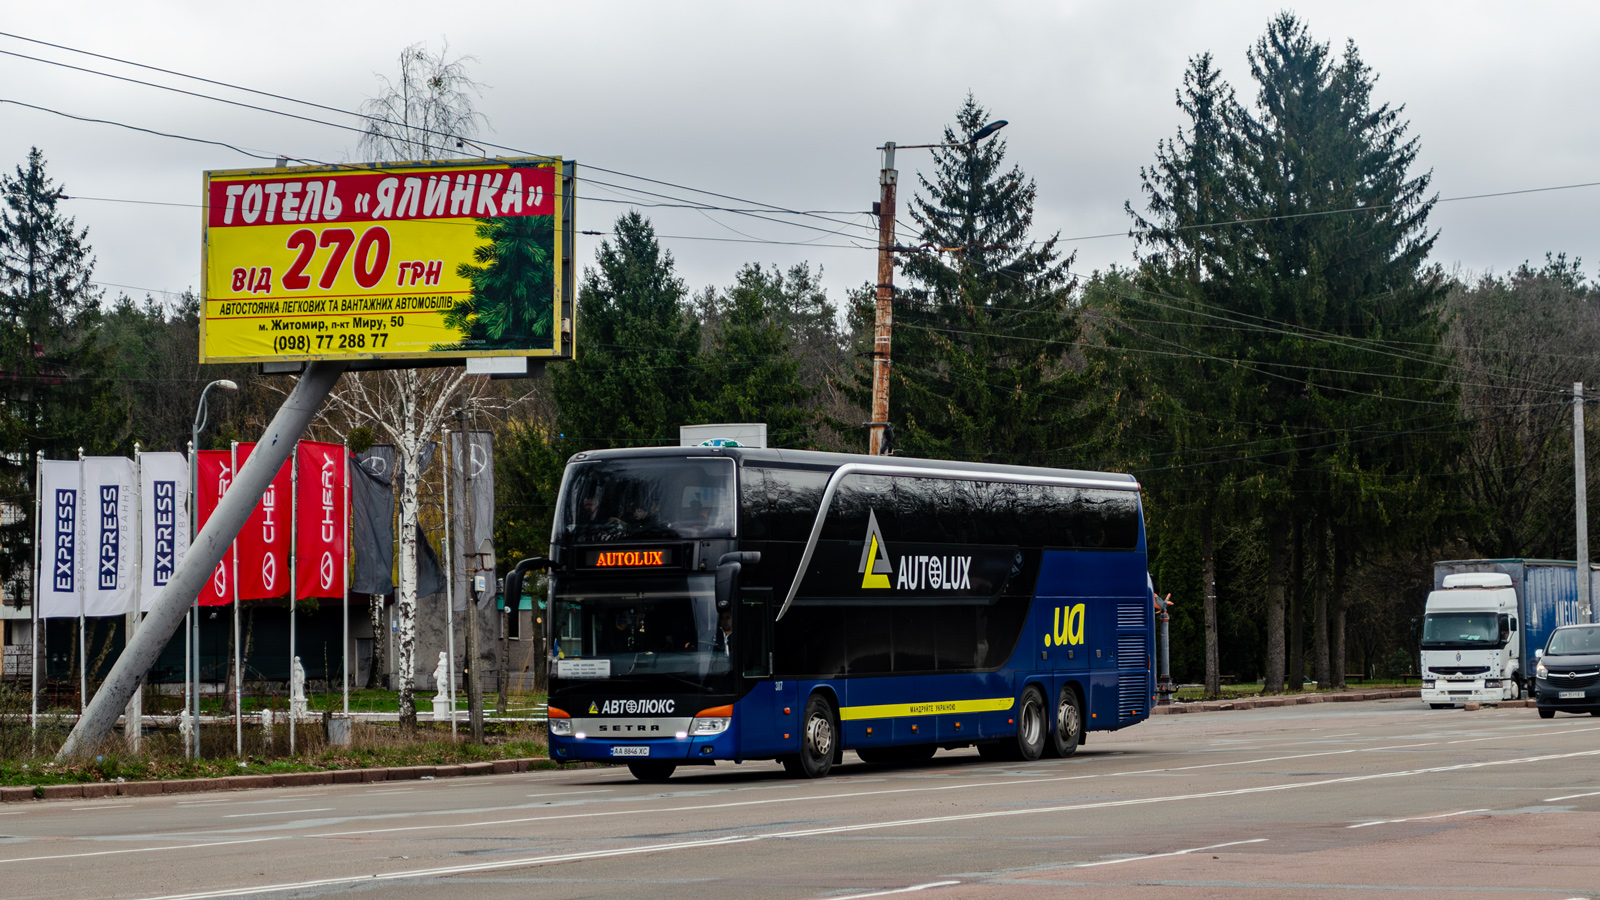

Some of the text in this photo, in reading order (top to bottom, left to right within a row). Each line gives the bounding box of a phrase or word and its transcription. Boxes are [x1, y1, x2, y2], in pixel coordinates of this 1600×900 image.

[223, 171, 543, 225] ГОТЕЛЬ «ЯЛИНКА»
[231, 225, 444, 294] ВІД 270 ГРН
[219, 295, 453, 316] АВТОСТОЯНКА ЛЕГКОВИХ ТА ВАНТАЖНИХ АВТОМОБІЛІВ
[258, 316, 405, 332] м. Житомир, п-кт Миру, 50
[273, 335, 311, 353] (098)
[315, 334, 333, 349] 77
[338, 334, 366, 349] 288
[370, 333, 389, 348] 77
[263, 483, 275, 543] CHE
[321, 452, 334, 543] CHERY
[56, 491, 74, 590] EXPRESS
[101, 487, 117, 588] EXPRESS
[118, 485, 130, 590] СТРАХУВАННЯ
[156, 483, 172, 583] EXPRESS
[596, 551, 664, 567] AUTOLUX
[896, 555, 972, 590] AUTOLUX
[1044, 603, 1085, 647] .ua
[601, 699, 675, 714] АВТОЛЮКС
[910, 703, 956, 713] МАНДРУЙТЕ УКРАЇНОЮ
[598, 724, 660, 732] SETRA
[613, 747, 623, 755] AA
[624, 747, 638, 755] 8846
